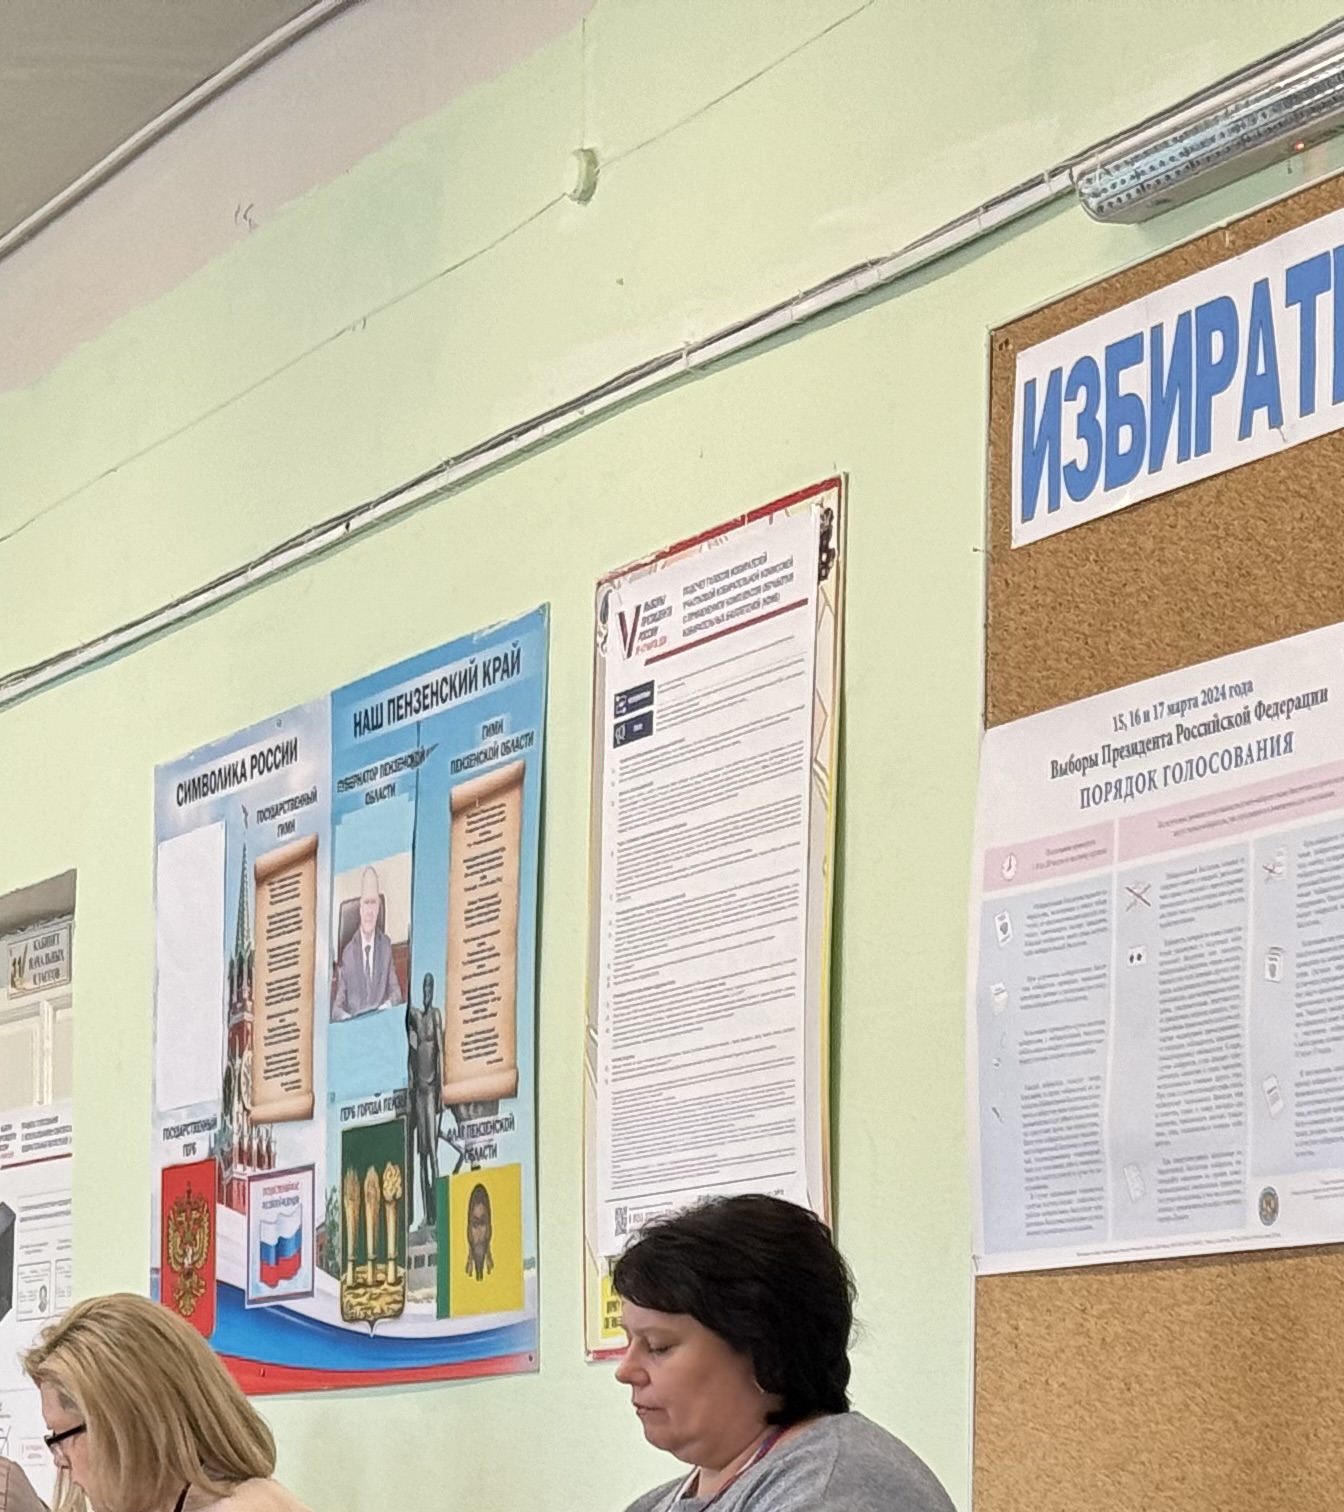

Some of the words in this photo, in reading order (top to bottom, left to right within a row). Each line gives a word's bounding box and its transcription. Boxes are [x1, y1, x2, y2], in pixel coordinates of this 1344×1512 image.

[353, 702, 384, 739] НАШ
[387, 657, 478, 727] ПЕНЗЕНСКИЙ
[482, 640, 521, 689] КРАЙ
[1129, 708, 1142, 728] 16
[1143, 709, 1151, 723] и
[1152, 701, 1165, 720] 17
[1167, 695, 1200, 718] марта
[1201, 683, 1227, 706] 2024
[1228, 679, 1254, 699] года
[176, 758, 247, 807] СИМВОЛИКА
[250, 736, 298, 780] РОССИИ
[1051, 753, 1099, 779] Выборы
[1101, 731, 1173, 769] Президента
[1175, 704, 1251, 745] Российской
[1254, 686, 1329, 721] Федерации
[1080, 768, 1158, 810] ПОРЯДОК
[1163, 731, 1295, 787] ГОЛОСОВАНИЯ
